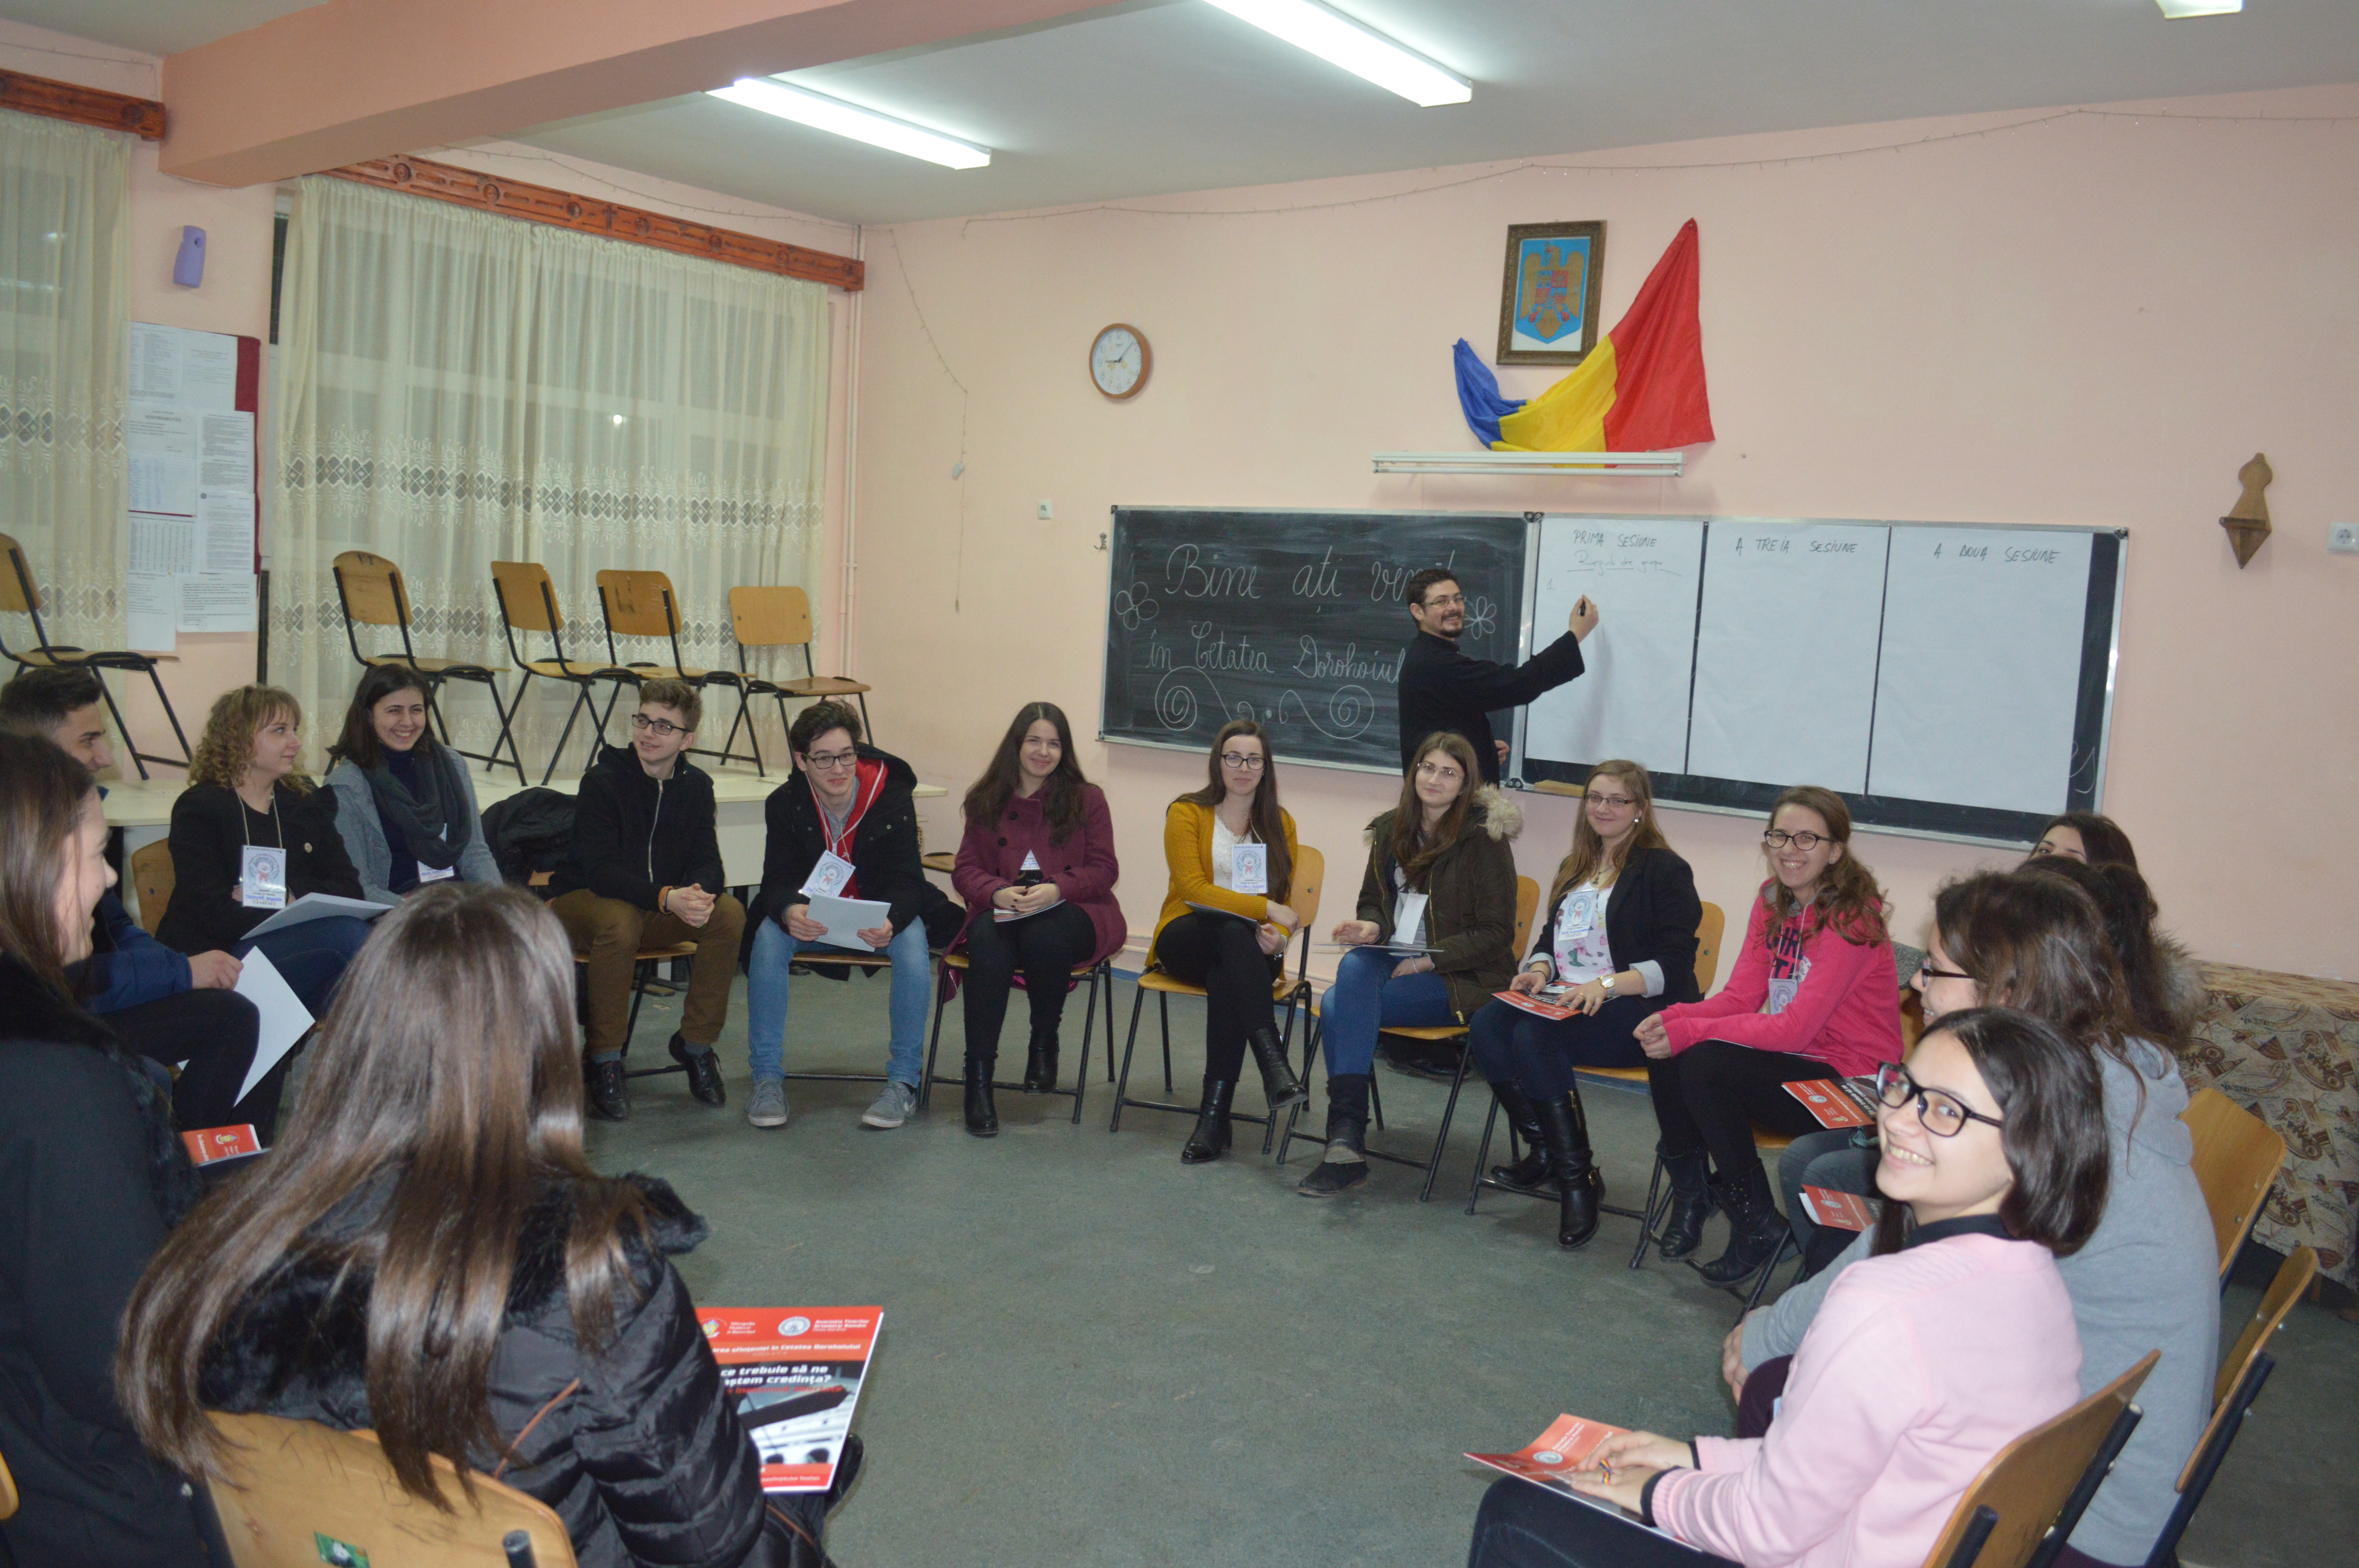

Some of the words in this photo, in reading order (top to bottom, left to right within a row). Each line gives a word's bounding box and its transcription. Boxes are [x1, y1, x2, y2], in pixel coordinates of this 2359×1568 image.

[1574, 529, 1604, 547] PRIMA
[1617, 534, 1657, 547] SESIUNE
[1736, 537, 1743, 556] A
[1810, 540, 1857, 552] SESIUNE
[1934, 543, 1941, 559] A
[2005, 546, 2059, 563] SESIUNE
[1165, 543, 1260, 599] Bine
[1191, 621, 1274, 673] Cetatea
[739, 1365, 788, 1375] trebuie
[791, 1364, 808, 1374] să
[767, 1374, 832, 1385] credința?
